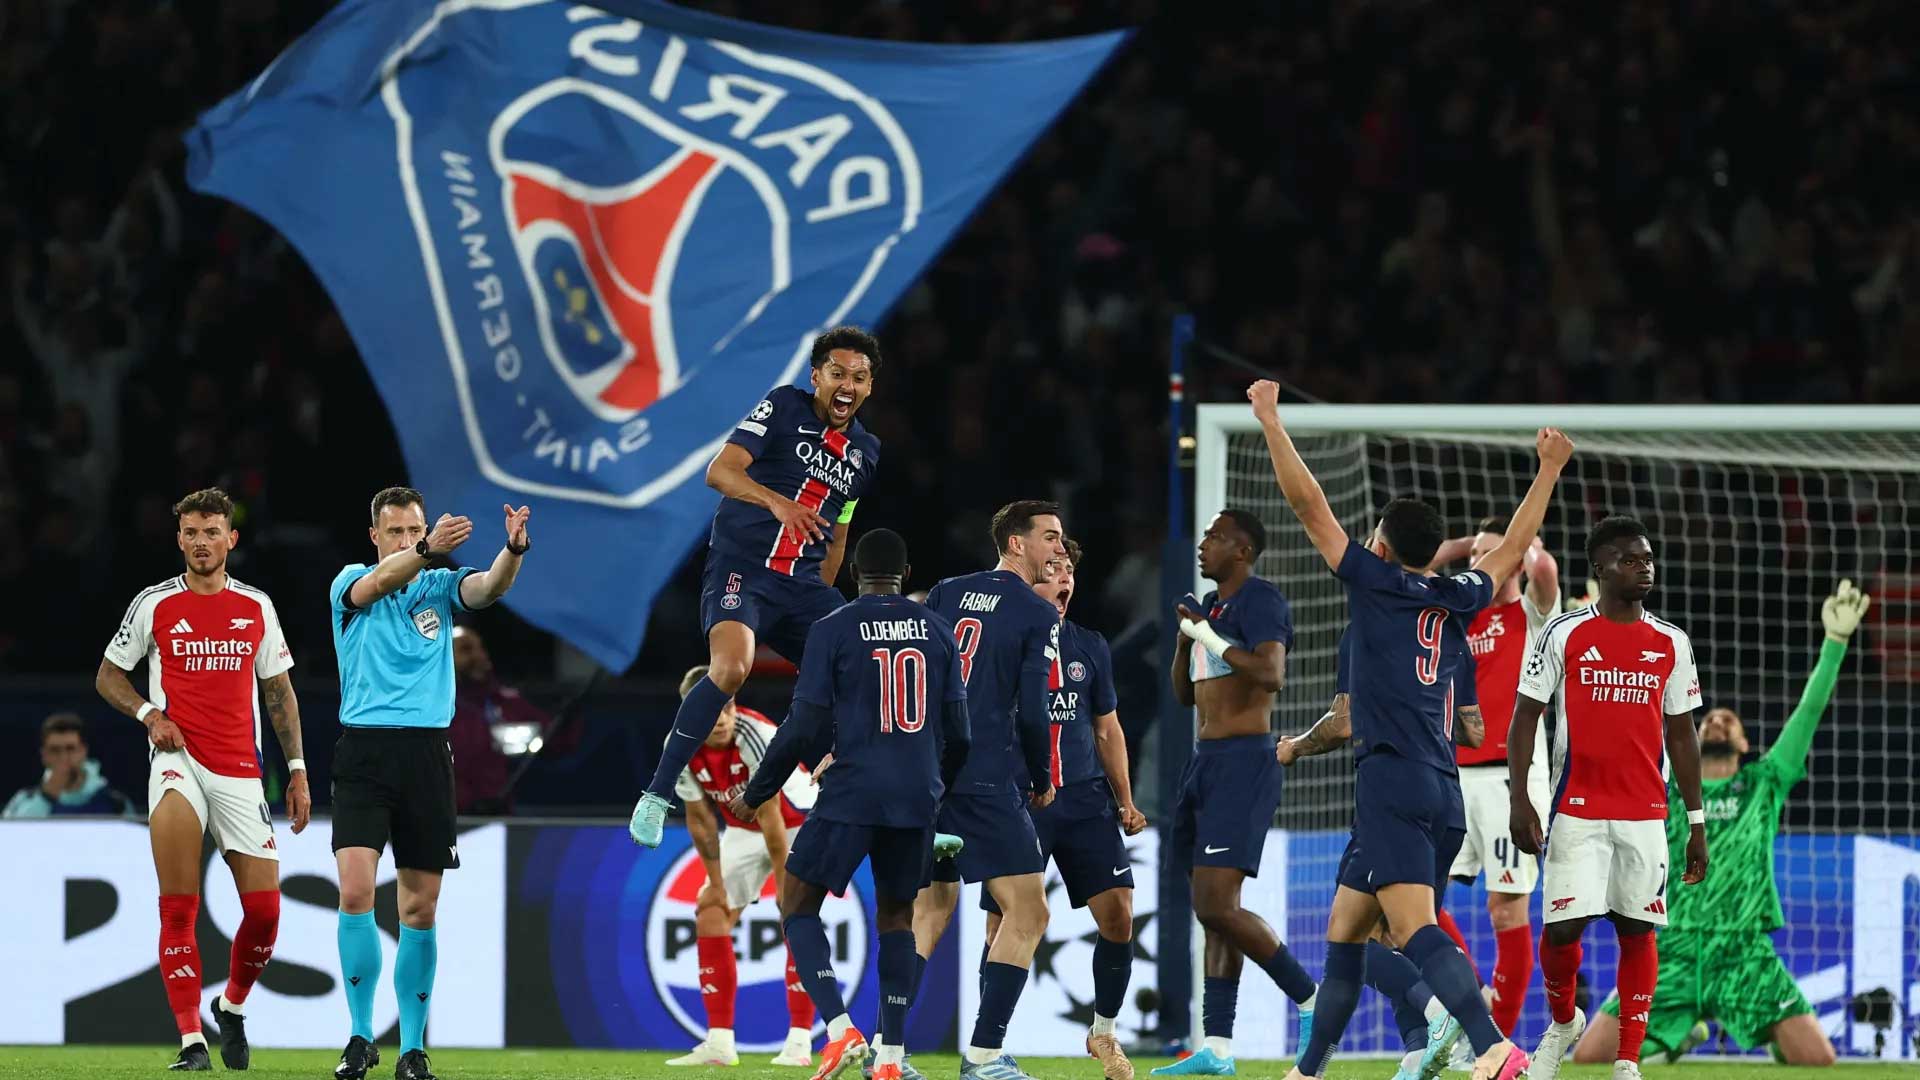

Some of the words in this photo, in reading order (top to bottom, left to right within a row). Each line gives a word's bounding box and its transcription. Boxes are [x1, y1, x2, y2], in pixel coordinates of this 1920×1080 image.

[805, 465, 851, 496] AIRWAYS
[726, 572, 742, 593] 5
[959, 591, 1001, 612] FABIAN
[172, 637, 253, 656] Emirates
[1416, 607, 1449, 685] 9
[185, 656, 201, 671] FLY
[205, 657, 241, 671] BETTER
[1579, 667, 1661, 690] Emirates
[872, 647, 927, 733] 10
[1591, 687, 1609, 702] FLY
[1613, 689, 1649, 704] BETTER
[259, 801, 274, 833] 4
[1494, 837, 1520, 868] 41
[664, 917, 848, 962] PPI
[164, 946, 192, 956] AFC
[1632, 993, 1653, 1002] AFC
